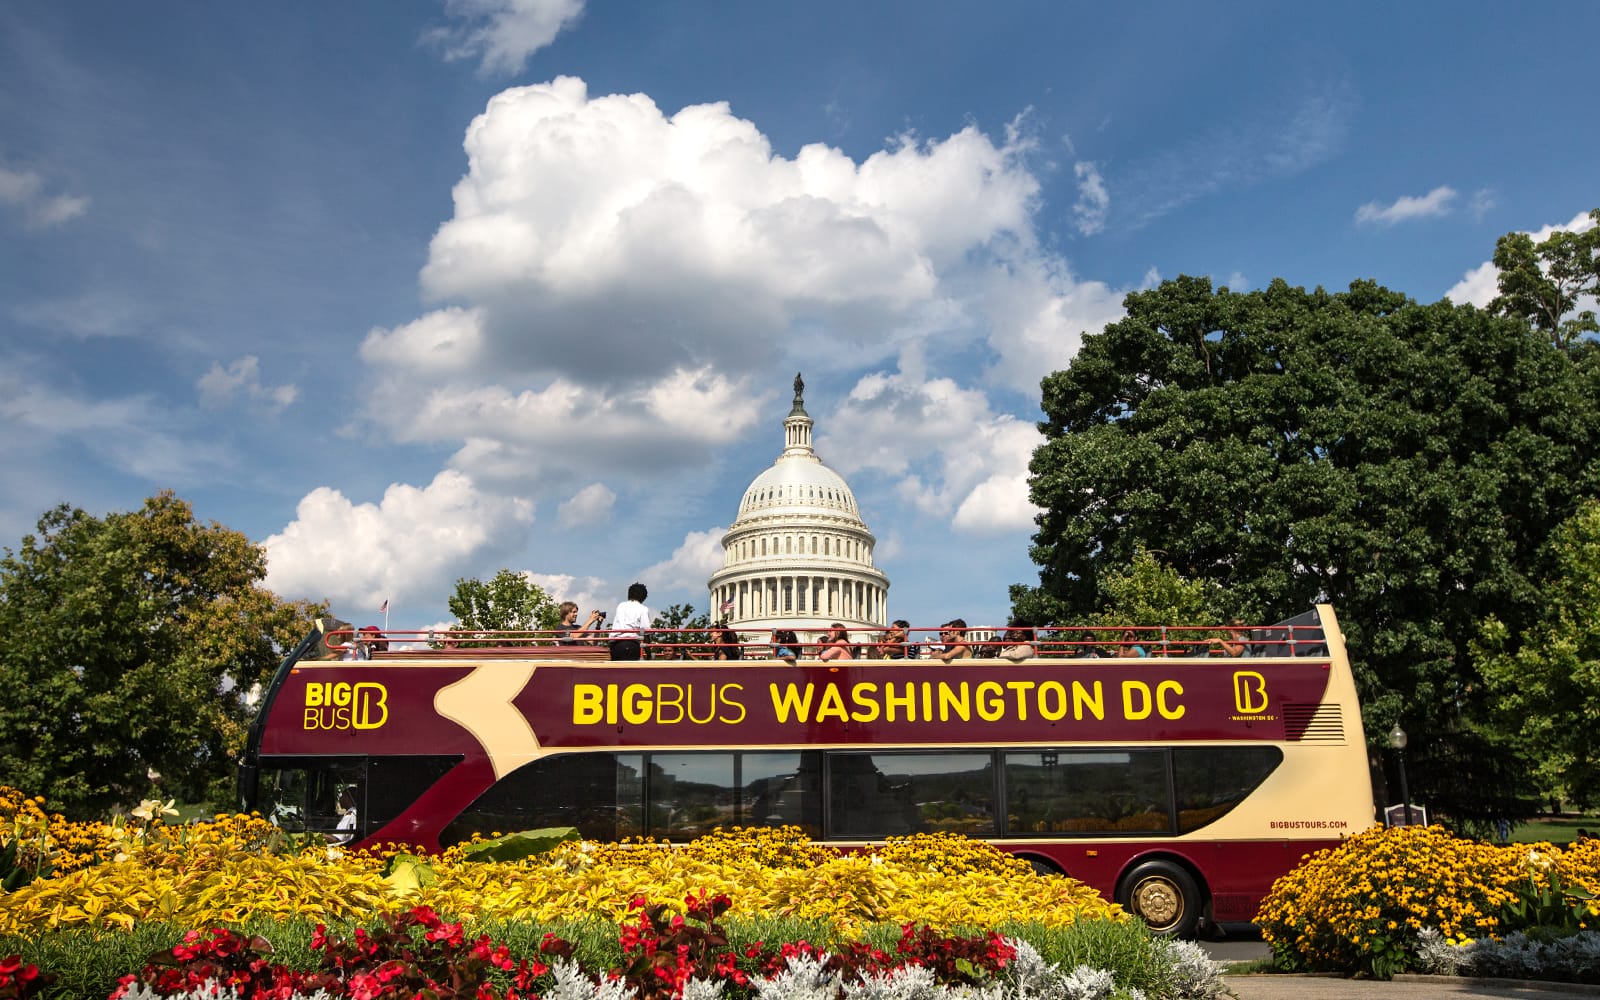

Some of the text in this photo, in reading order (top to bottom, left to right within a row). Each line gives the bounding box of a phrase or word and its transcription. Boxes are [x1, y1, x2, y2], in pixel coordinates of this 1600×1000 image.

[305, 682, 352, 707] BIG
[769, 681, 1105, 724] WASHINGTON
[1121, 680, 1186, 720] DC
[303, 707, 351, 730] BUS
[1270, 821, 1348, 829] BIGBUSTOURS.COM
